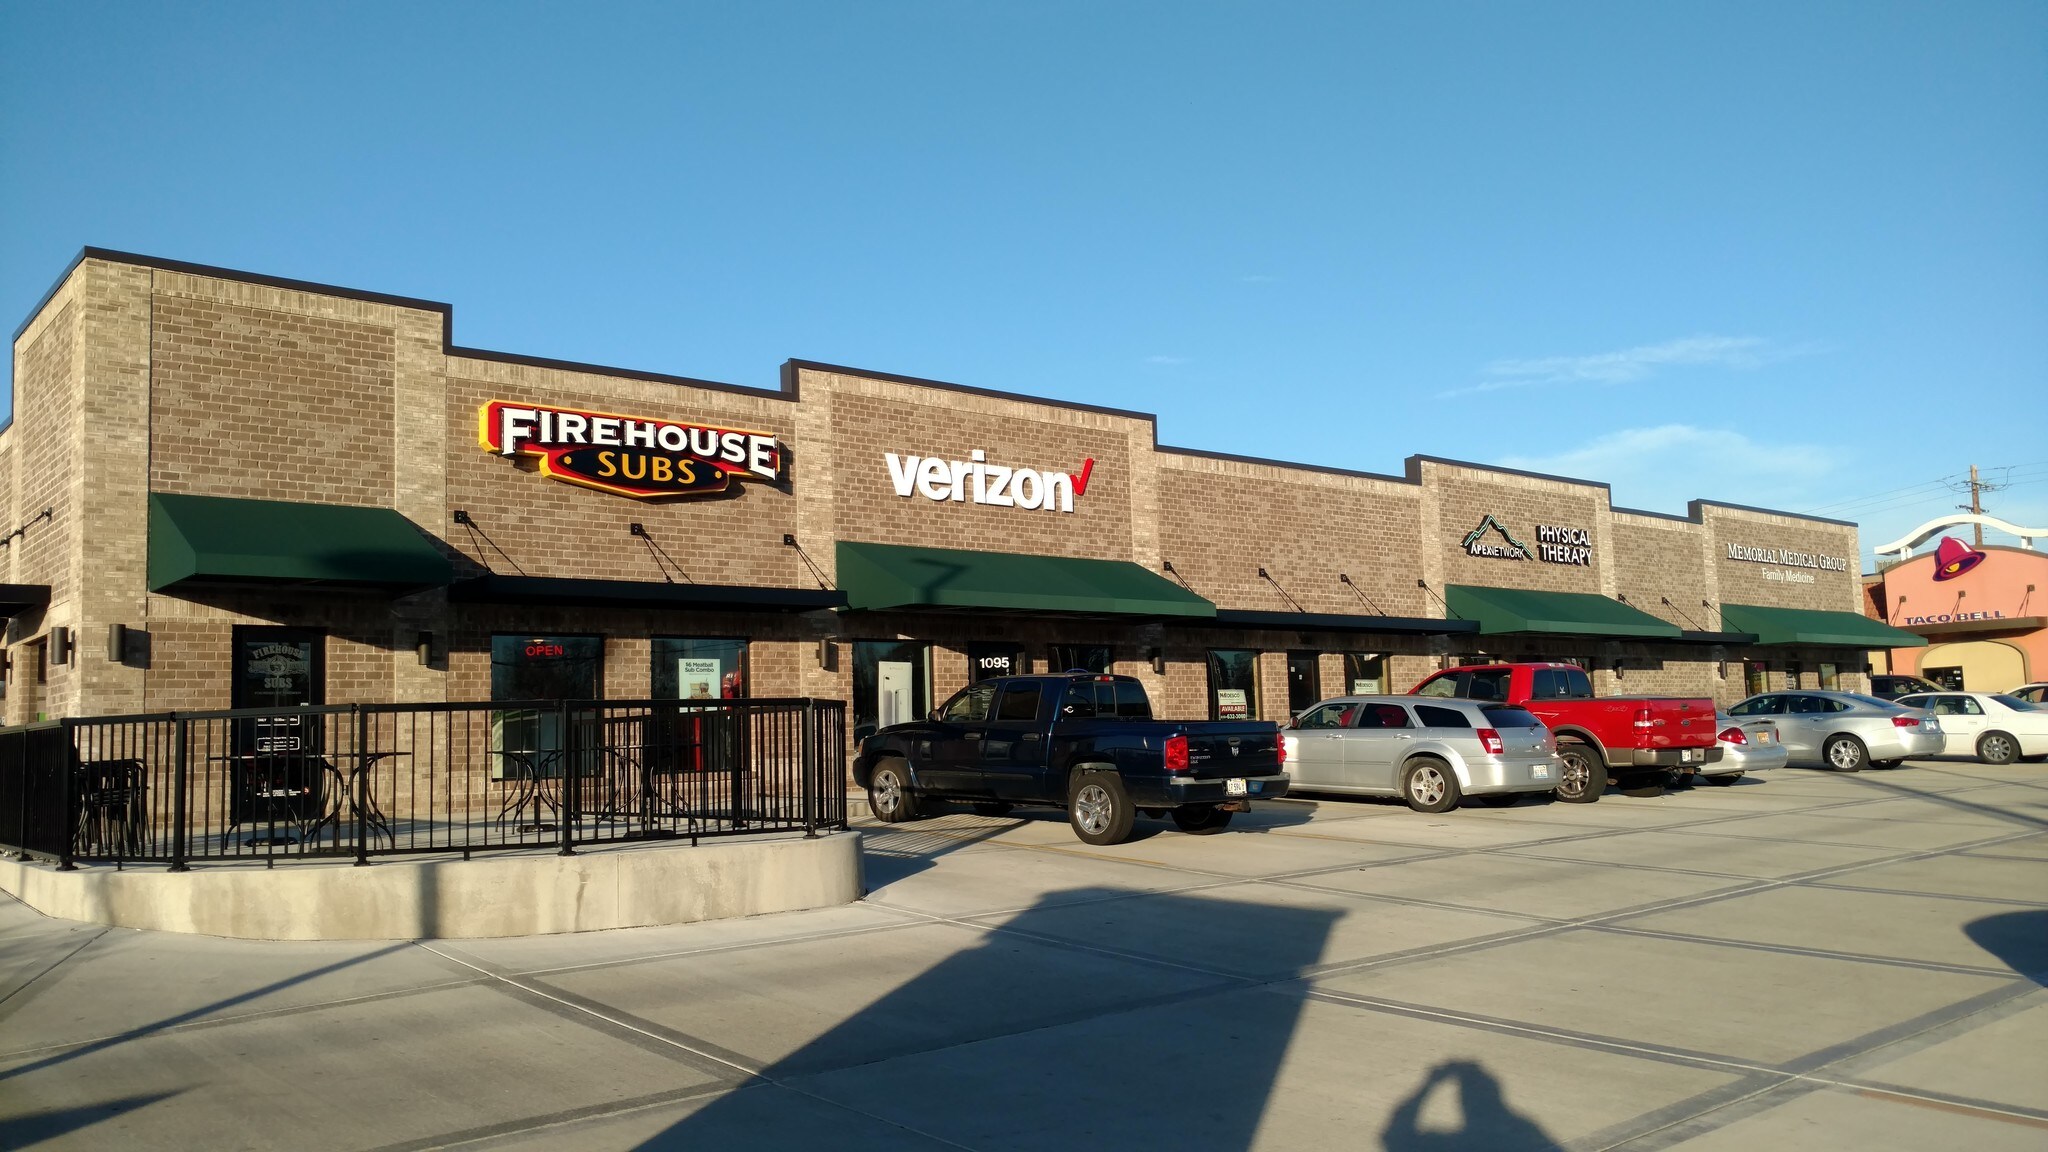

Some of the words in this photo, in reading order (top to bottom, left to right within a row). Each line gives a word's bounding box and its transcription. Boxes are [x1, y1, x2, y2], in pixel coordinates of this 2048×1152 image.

[501, 407, 778, 480] FIREHOUSE
[597, 451, 696, 484] SUBS
[884, 449, 1075, 513] verizon
[1539, 525, 1592, 547] PHYSICAL
[1540, 544, 1592, 565] THERAPY
[1727, 543, 1778, 564] MEMORIAL
[1779, 548, 1819, 569] MEDICAL
[1819, 553, 1847, 572] GROUP
[1762, 567, 1785, 583] Family
[1785, 570, 1815, 584] Medicine
[1904, 614, 1951, 625] TACO
[1956, 610, 2006, 621] BELL
[253, 645, 304, 659] FIREHOUSE
[525, 645, 563, 656] OPEN
[979, 656, 1010, 669] 1095
[264, 677, 293, 689] SUBS
